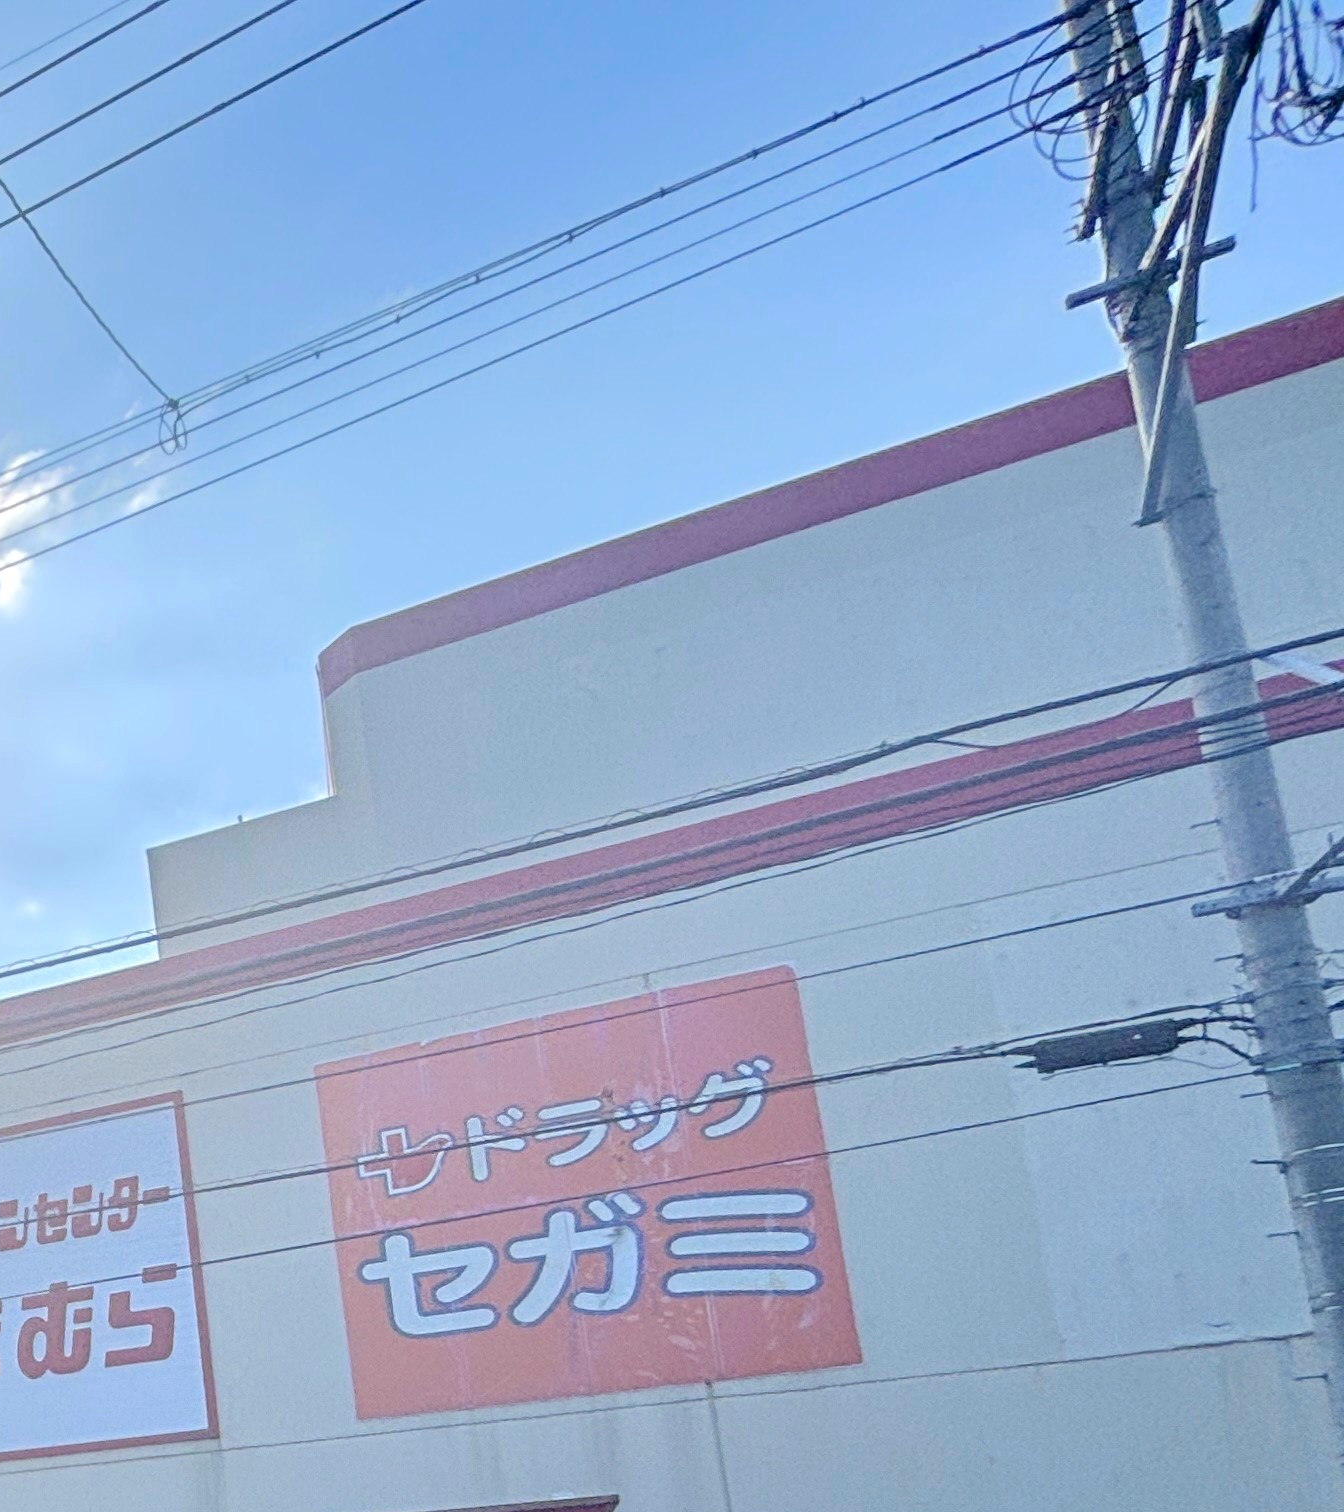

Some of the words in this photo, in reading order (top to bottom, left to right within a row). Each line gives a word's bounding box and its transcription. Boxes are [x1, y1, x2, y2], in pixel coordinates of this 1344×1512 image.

[464, 1058, 776, 1184] ドラッグ
[360, 1189, 821, 1338] セガミ
